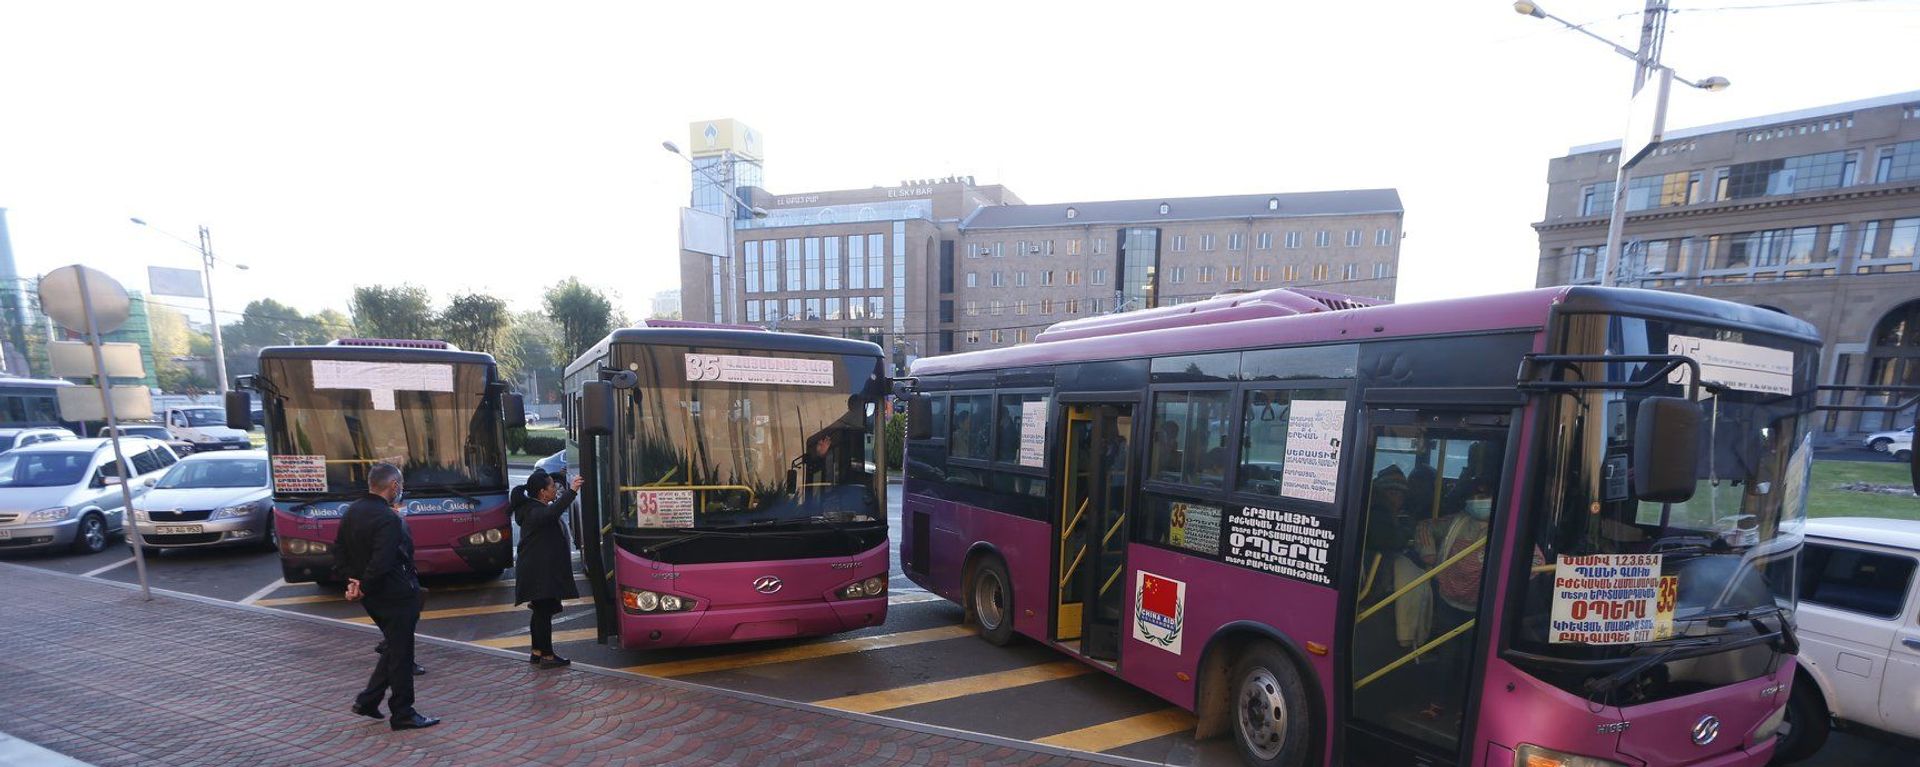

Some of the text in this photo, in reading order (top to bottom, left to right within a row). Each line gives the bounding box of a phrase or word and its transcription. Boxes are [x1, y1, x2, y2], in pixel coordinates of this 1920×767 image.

[888, 187, 933, 198] EL SKY BAR
[686, 355, 721, 380] 35
[1321, 409, 1343, 431] 35
[1286, 448, 1337, 459] ՍԵԲԱՍՏԻ
[640, 492, 657, 515] 35
[1172, 503, 1187, 528] 35
[1242, 506, 1320, 527] ՇՐՋԱՆԱՅԻՆ
[1228, 515, 1335, 540] ԲԺՇԿԱԿԱՆ ՀԱՄԱԼՍԱՐԱՆ
[1229, 532, 1328, 565] ՕՊԵՐԱ
[1244, 550, 1325, 573] ԲԱՂՐԱՄՅԱՆ
[1575, 567, 1650, 578] ՊԼԱՆԻ ԳԼՈՒԽ
[1556, 577, 1612, 589] ԲԺՇԿԱԿԱՆ
[1657, 577, 1677, 613] 35
[1141, 609, 1161, 621] CHINA
[1162, 617, 1175, 625] AID
[1571, 600, 1647, 620] ՕՊԵՐԱ
